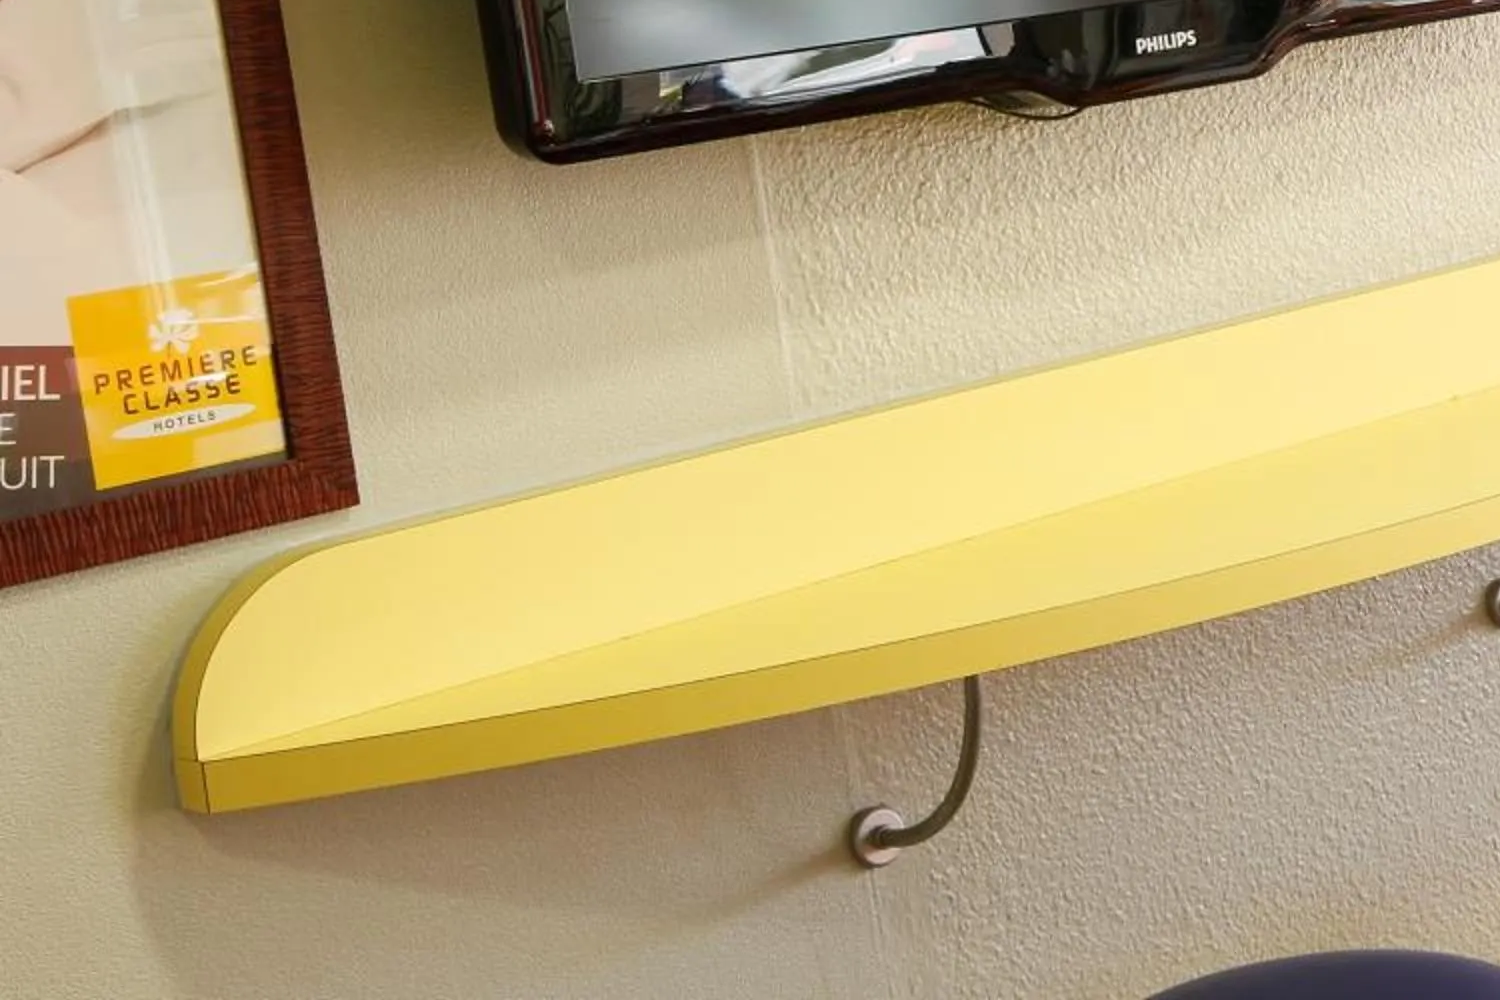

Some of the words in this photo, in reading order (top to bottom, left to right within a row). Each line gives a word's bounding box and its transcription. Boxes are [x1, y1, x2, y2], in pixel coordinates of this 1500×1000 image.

[1135, 29, 1198, 55] PHILIPS
[1, 364, 61, 401] IEL
[93, 345, 257, 395] PREMIERE
[123, 373, 241, 415] CLASSE
[152, 410, 217, 433] HOTELS
[0, 454, 65, 490] UIT
